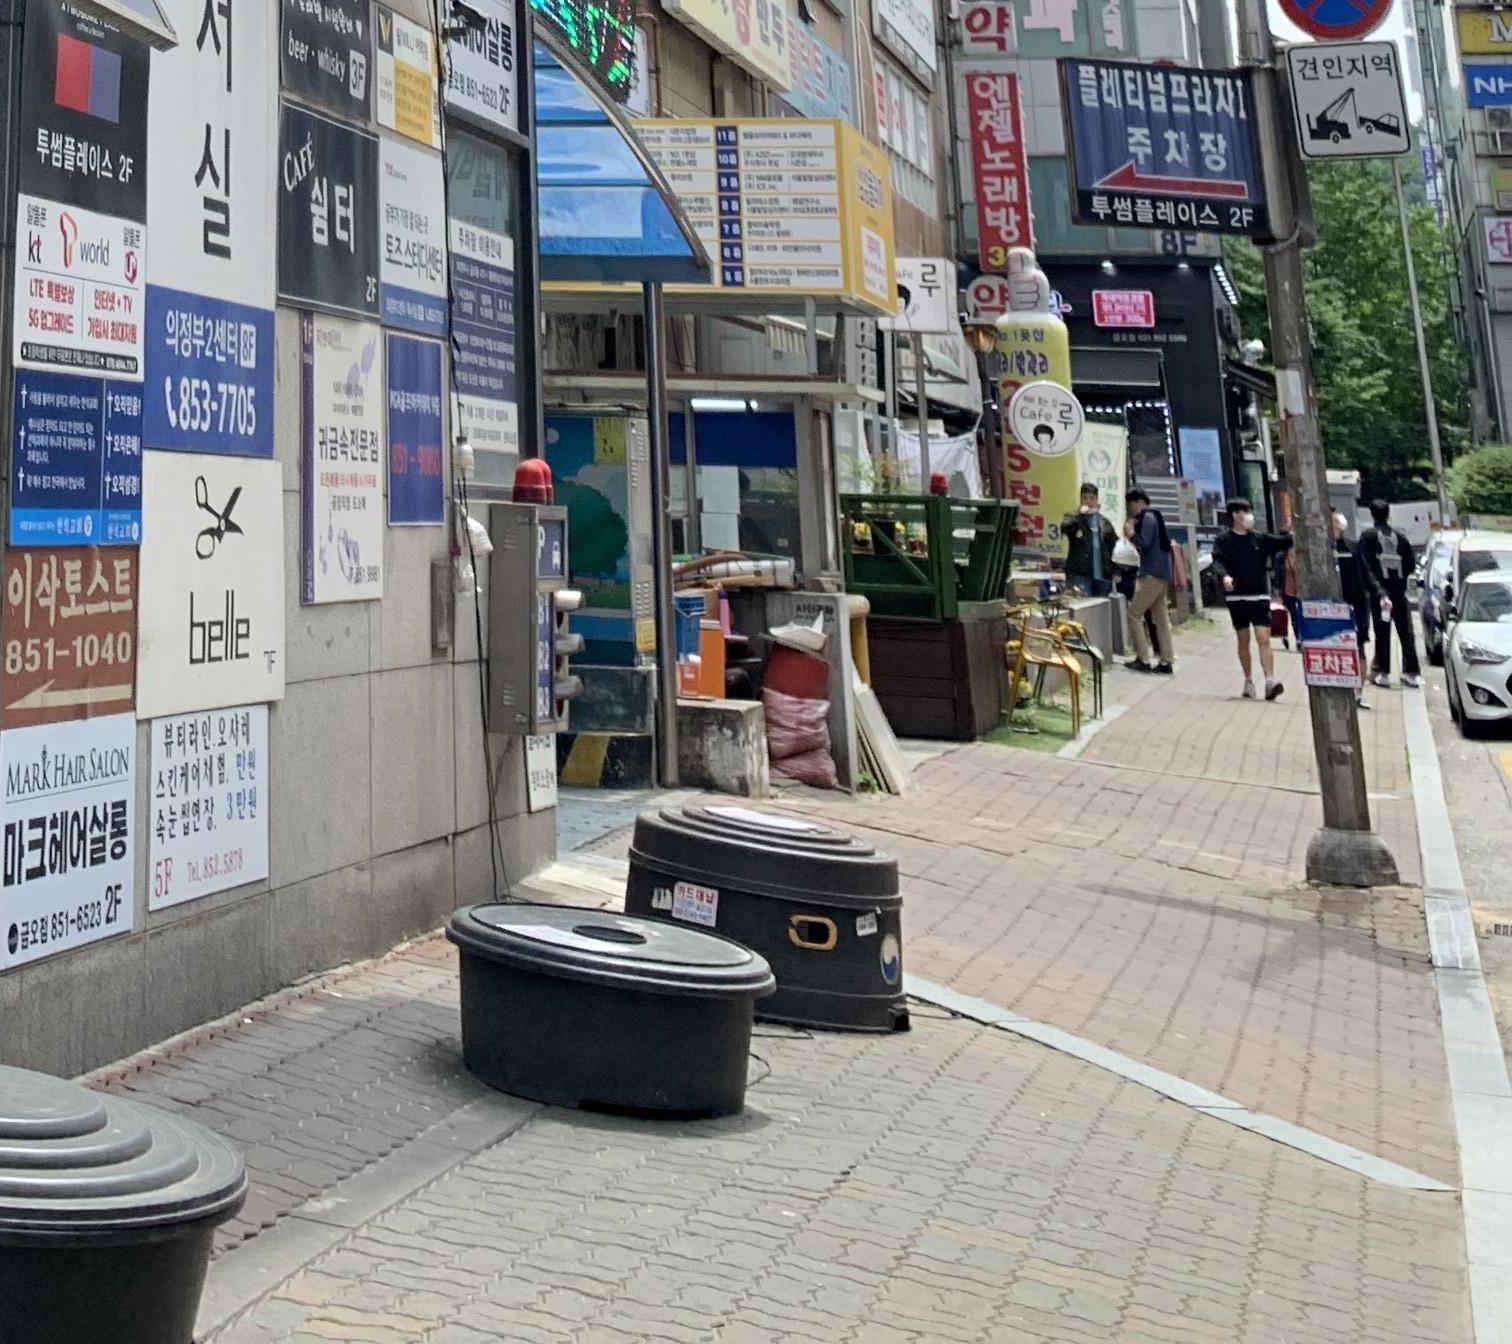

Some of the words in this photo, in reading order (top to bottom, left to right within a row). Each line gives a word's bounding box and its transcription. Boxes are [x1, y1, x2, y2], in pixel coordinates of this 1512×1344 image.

[965, 6, 1010, 51] 약
[288, 30, 309, 62] beer
[318, 45, 346, 82] whisky
[1297, 53, 1395, 82] 견인지역
[499, 83, 510, 115] 2F
[36, 127, 113, 182] 투썸플레이스
[118, 154, 133, 184] 2F
[283, 130, 316, 192] CAFÉ
[1127, 126, 1227, 173] 주차장
[311, 174, 356, 255] 쉼터
[1091, 196, 1220, 227] 투썸플레이스
[1230, 208, 1254, 228] 2F
[28, 230, 42, 264] kt
[80, 233, 109, 267] world
[29, 277, 43, 298] LTE
[123, 294, 132, 314] TV
[366, 276, 378, 303] 2F
[165, 309, 239, 365] 의정부2센터
[242, 324, 254, 361] 8F
[177, 376, 256, 436] 853-7705
[1020, 406, 1052, 423] Cafe
[318, 423, 378, 465] 귀금속전문점
[7, 553, 133, 629] 이삭토스트
[189, 590, 250, 665] belle
[5, 631, 132, 675] 851-1040
[6, 745, 51, 798] MARK
[54, 752, 87, 786] HAIR
[90, 747, 129, 780] SALON
[235, 748, 256, 781] 만원
[3, 799, 128, 887] 마크헤어살롱
[154, 857, 174, 898] 5F
[20, 916, 48, 950] 금오점
[51, 900, 102, 941] 851-6523
[106, 884, 122, 925] 2F
